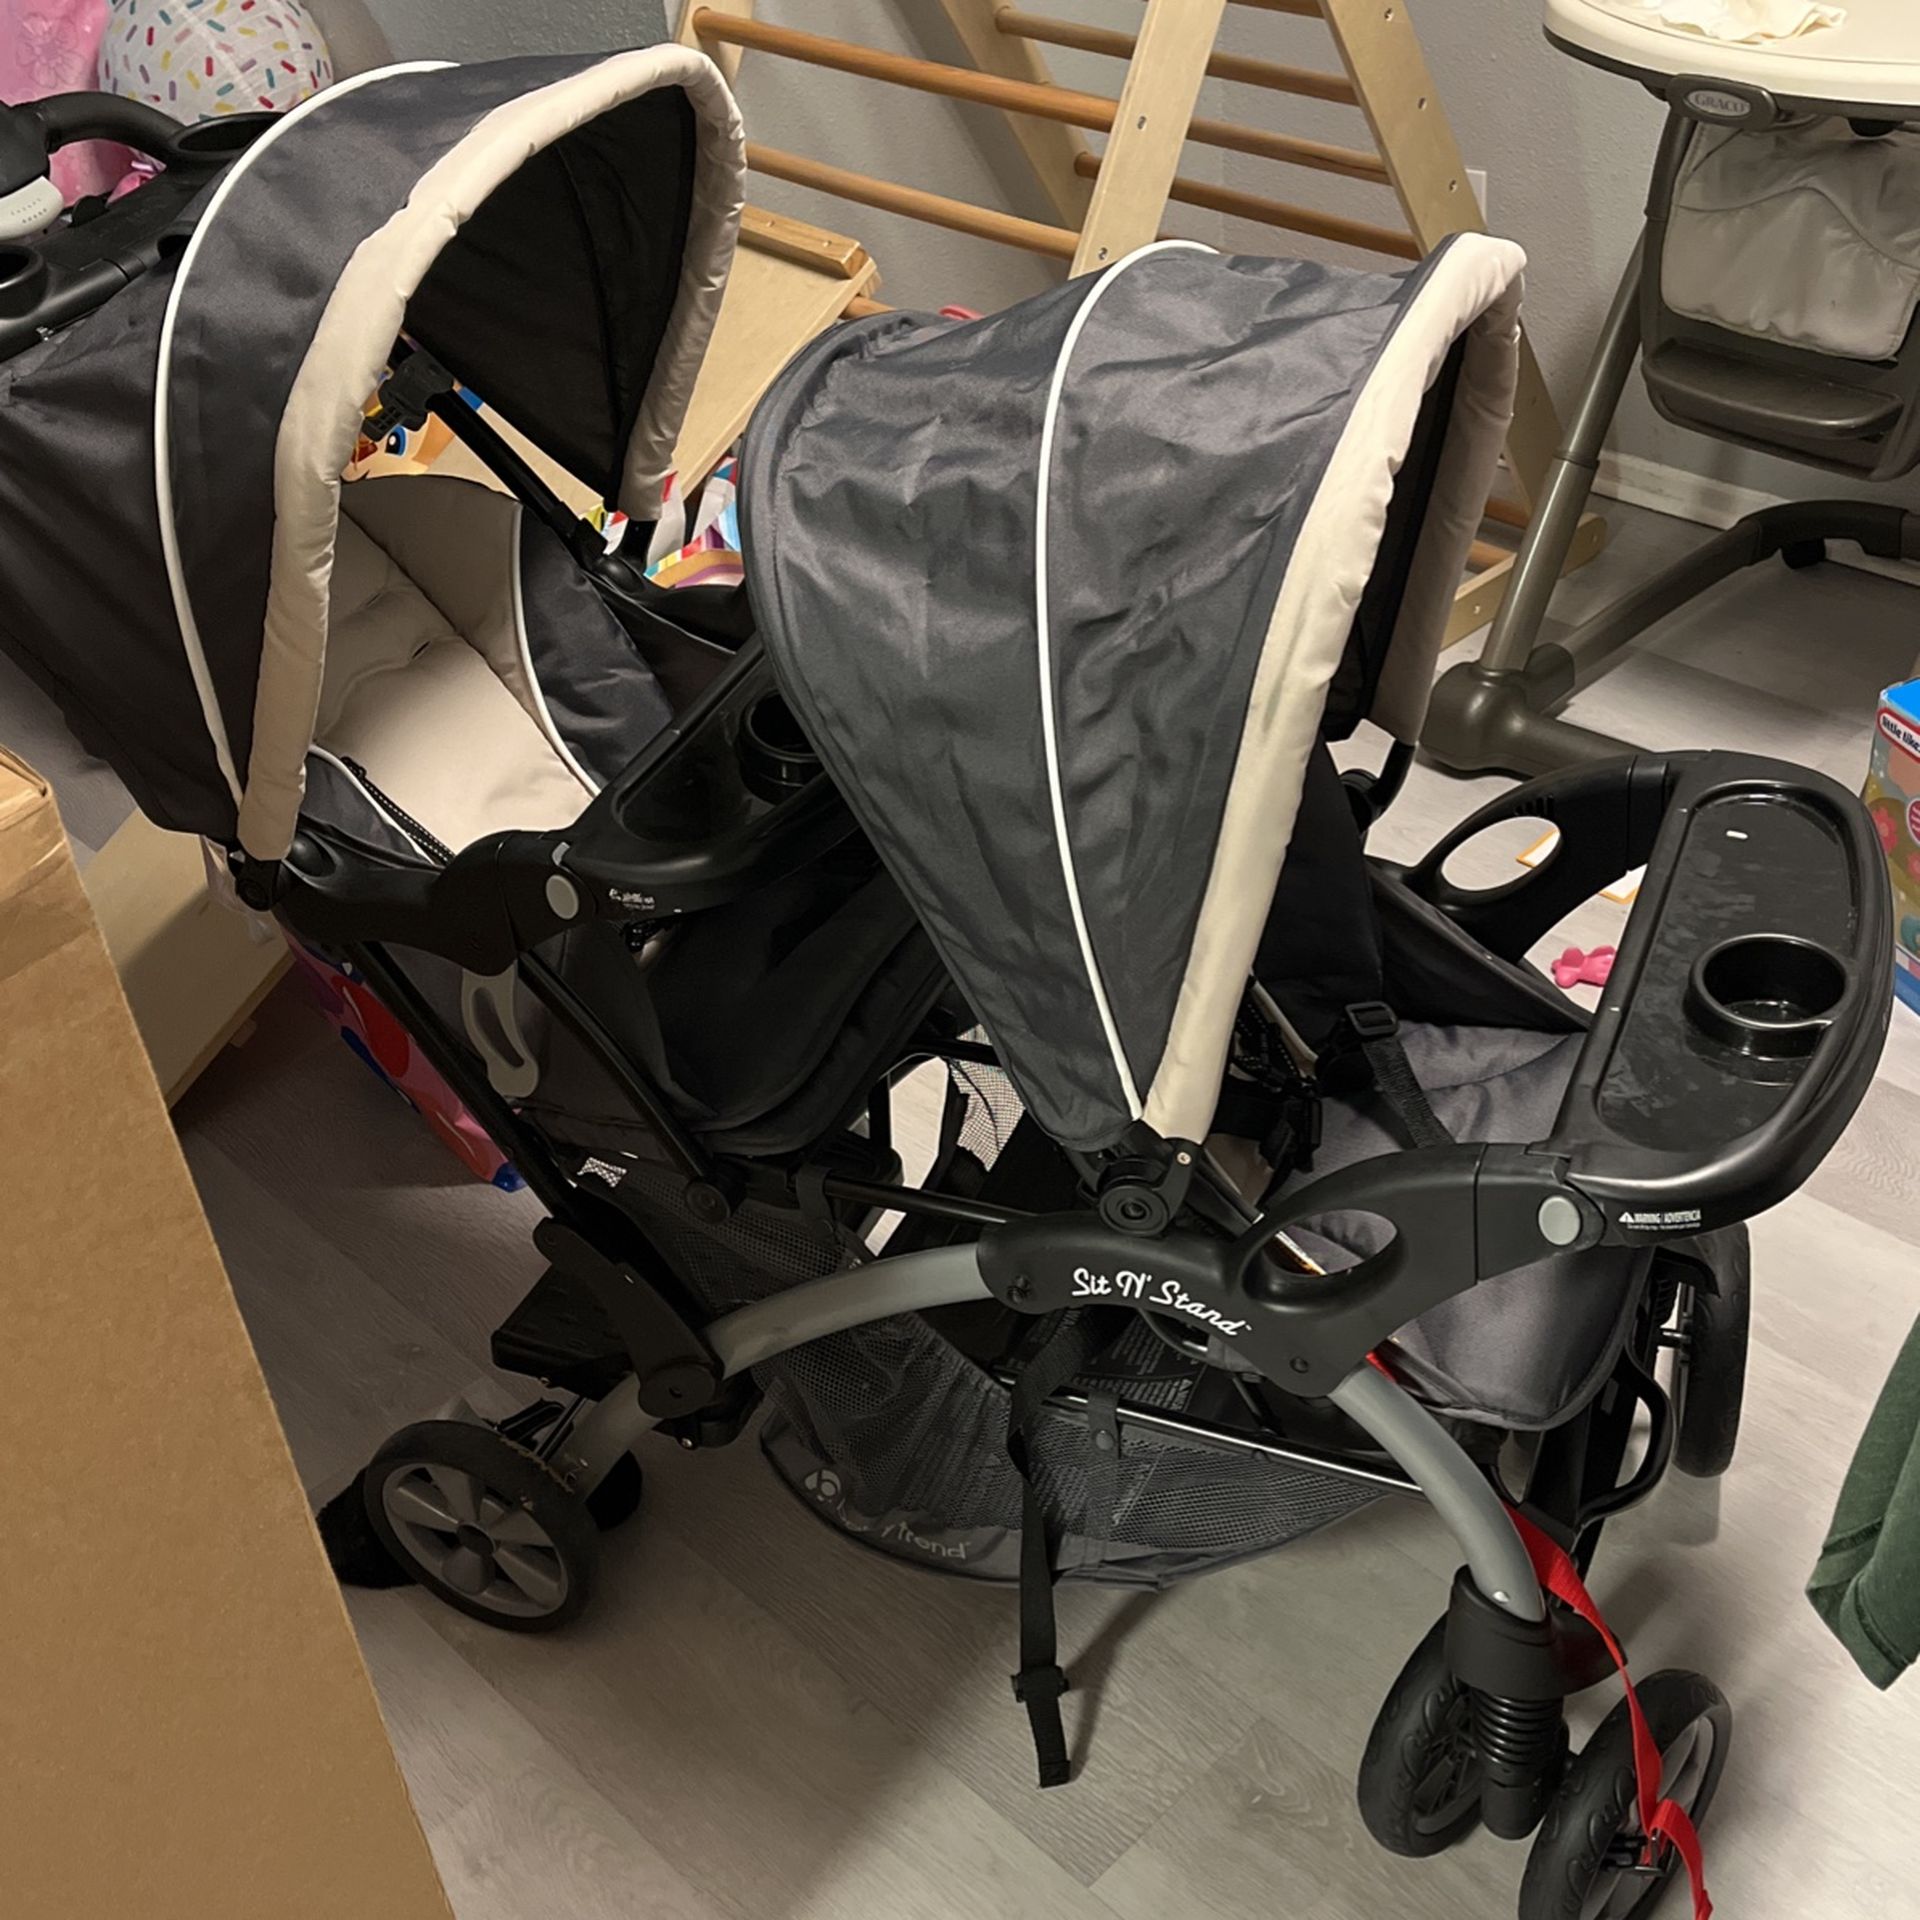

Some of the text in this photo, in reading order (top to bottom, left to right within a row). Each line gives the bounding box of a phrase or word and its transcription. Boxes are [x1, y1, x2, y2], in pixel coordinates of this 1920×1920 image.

[1694, 93, 1745, 113] GRACO
[1071, 1267, 1111, 1296] Sit
[1149, 1280, 1247, 1336] Stand
